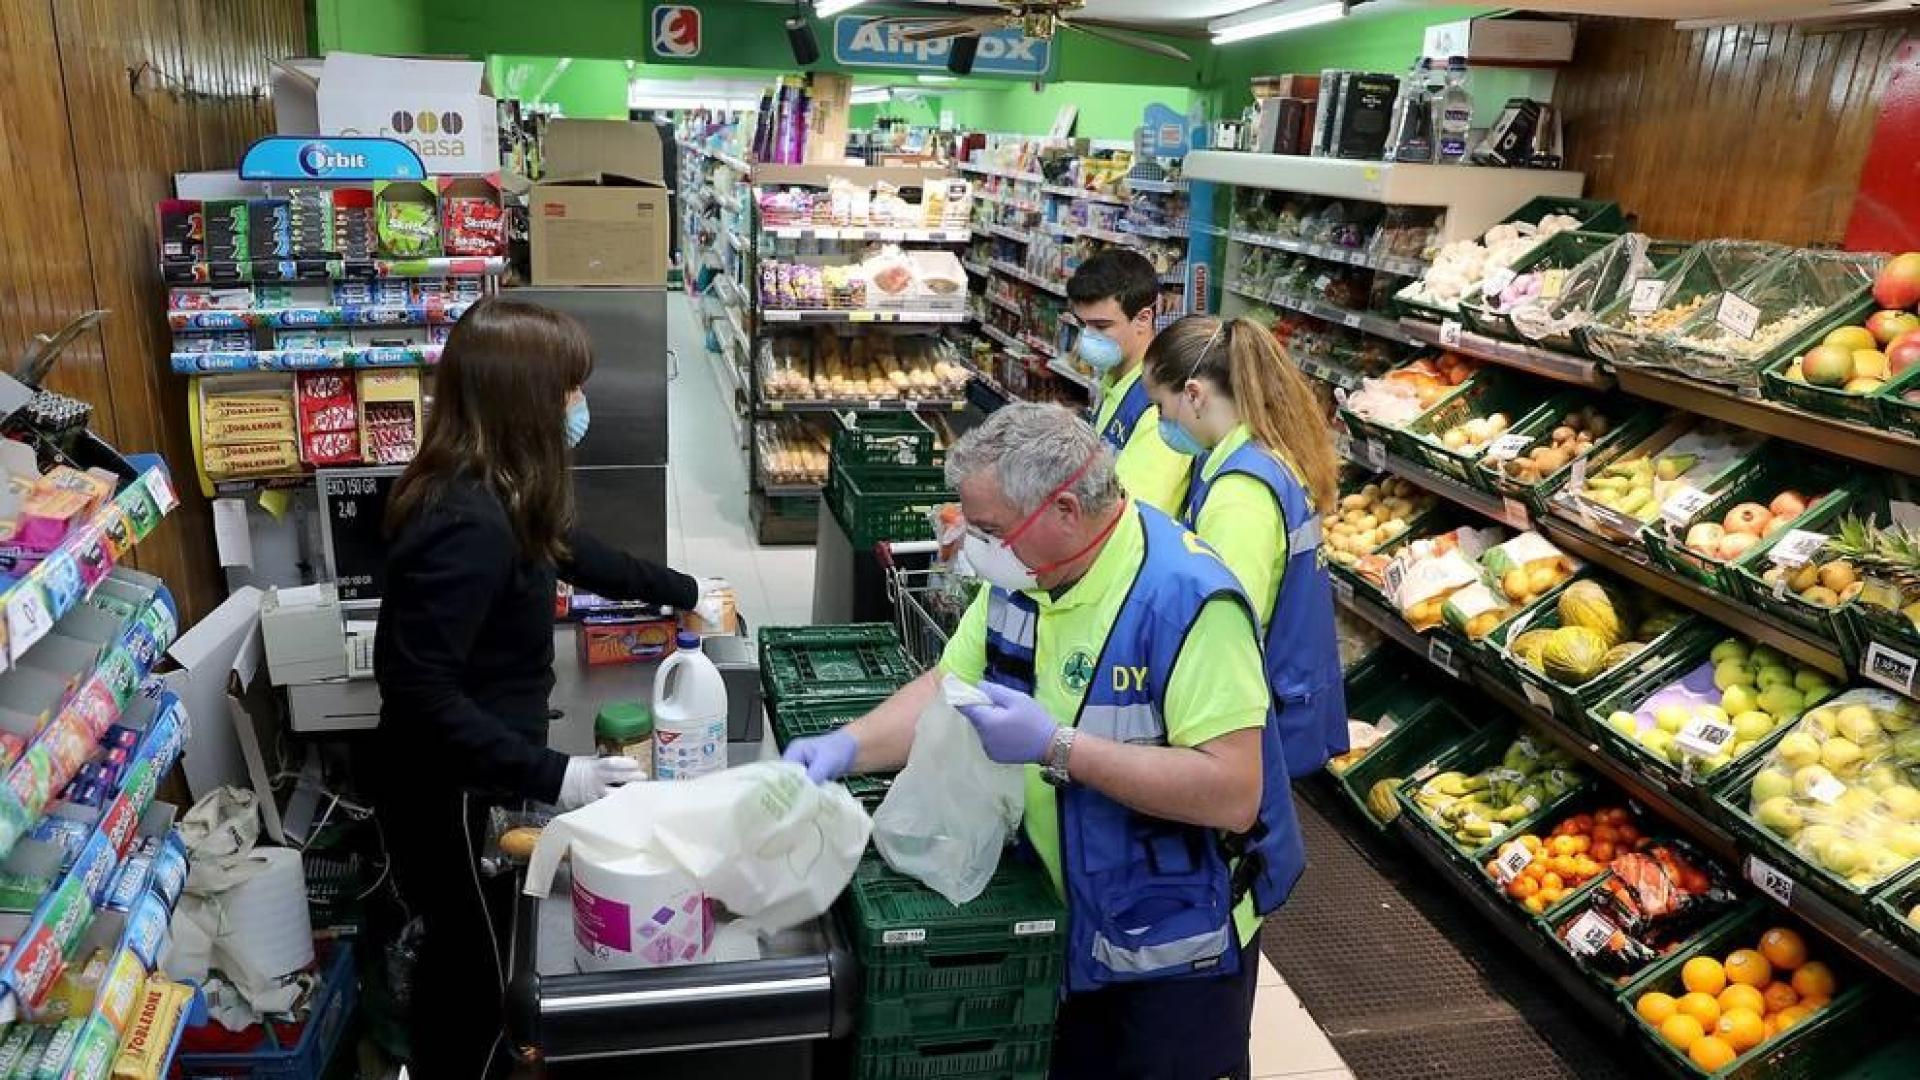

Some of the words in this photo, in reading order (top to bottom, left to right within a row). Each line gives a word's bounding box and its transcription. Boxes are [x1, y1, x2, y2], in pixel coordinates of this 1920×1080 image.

[850, 17, 1035, 61] Alipox
[299, 143, 366, 176] Orbit
[1112, 665, 1148, 691] DY
[126, 990, 162, 1055] TOBLERONE
